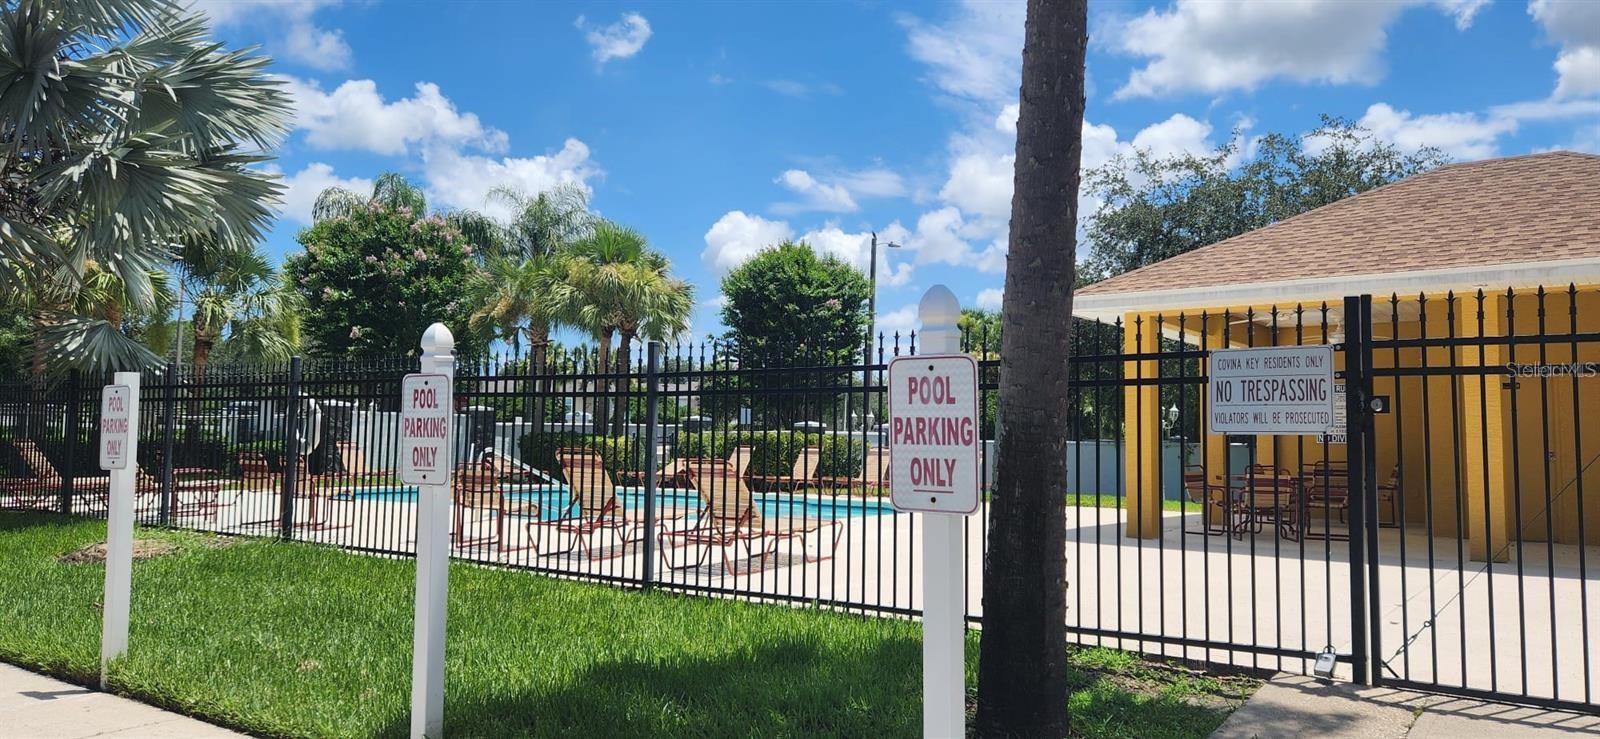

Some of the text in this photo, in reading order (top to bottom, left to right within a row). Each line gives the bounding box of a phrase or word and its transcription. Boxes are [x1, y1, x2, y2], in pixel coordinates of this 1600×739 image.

[1217, 355, 1324, 371] COVINA KEY RESIDENTS ONLY
[413, 388, 438, 409] POOL
[908, 376, 956, 405] POOL
[1215, 378, 1327, 403] NO TRESPASSING
[108, 396, 123, 412] POOL
[102, 418, 128, 434] PARKING
[404, 417, 447, 439] PARKING
[1214, 411, 1330, 425] VIOLATORS WILL BE PROSECUTED
[893, 416, 973, 446] PARKING
[106, 440, 121, 455] ONLY
[412, 446, 438, 467] ONLY
[910, 457, 956, 487] ONLY
